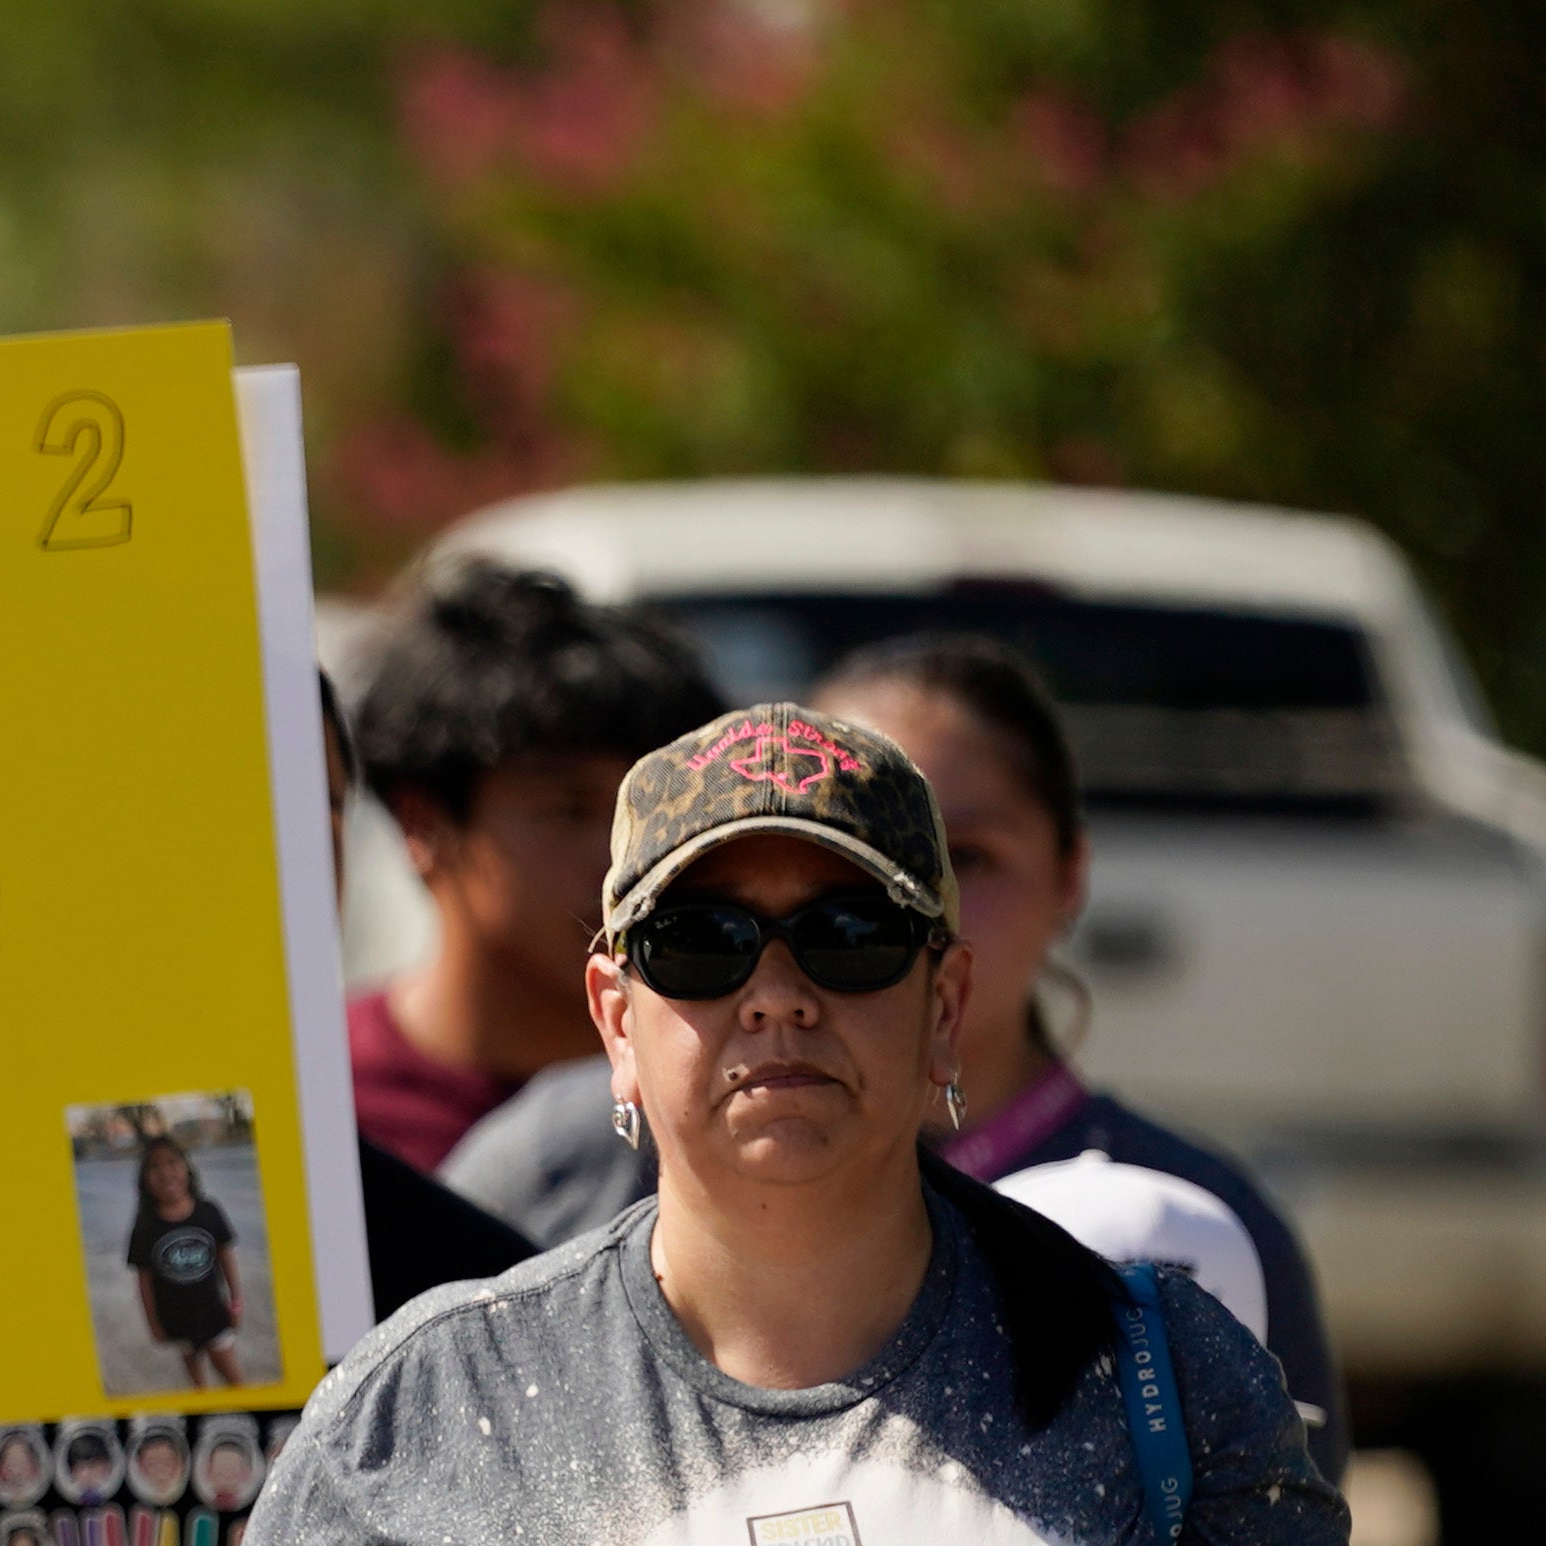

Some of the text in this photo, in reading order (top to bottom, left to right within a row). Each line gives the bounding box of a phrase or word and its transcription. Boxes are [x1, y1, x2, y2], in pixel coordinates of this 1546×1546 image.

[36, 389, 132, 551] 2
[686, 719, 862, 771] Uvalde Strong
[762, 1511, 844, 1541] SISTER
